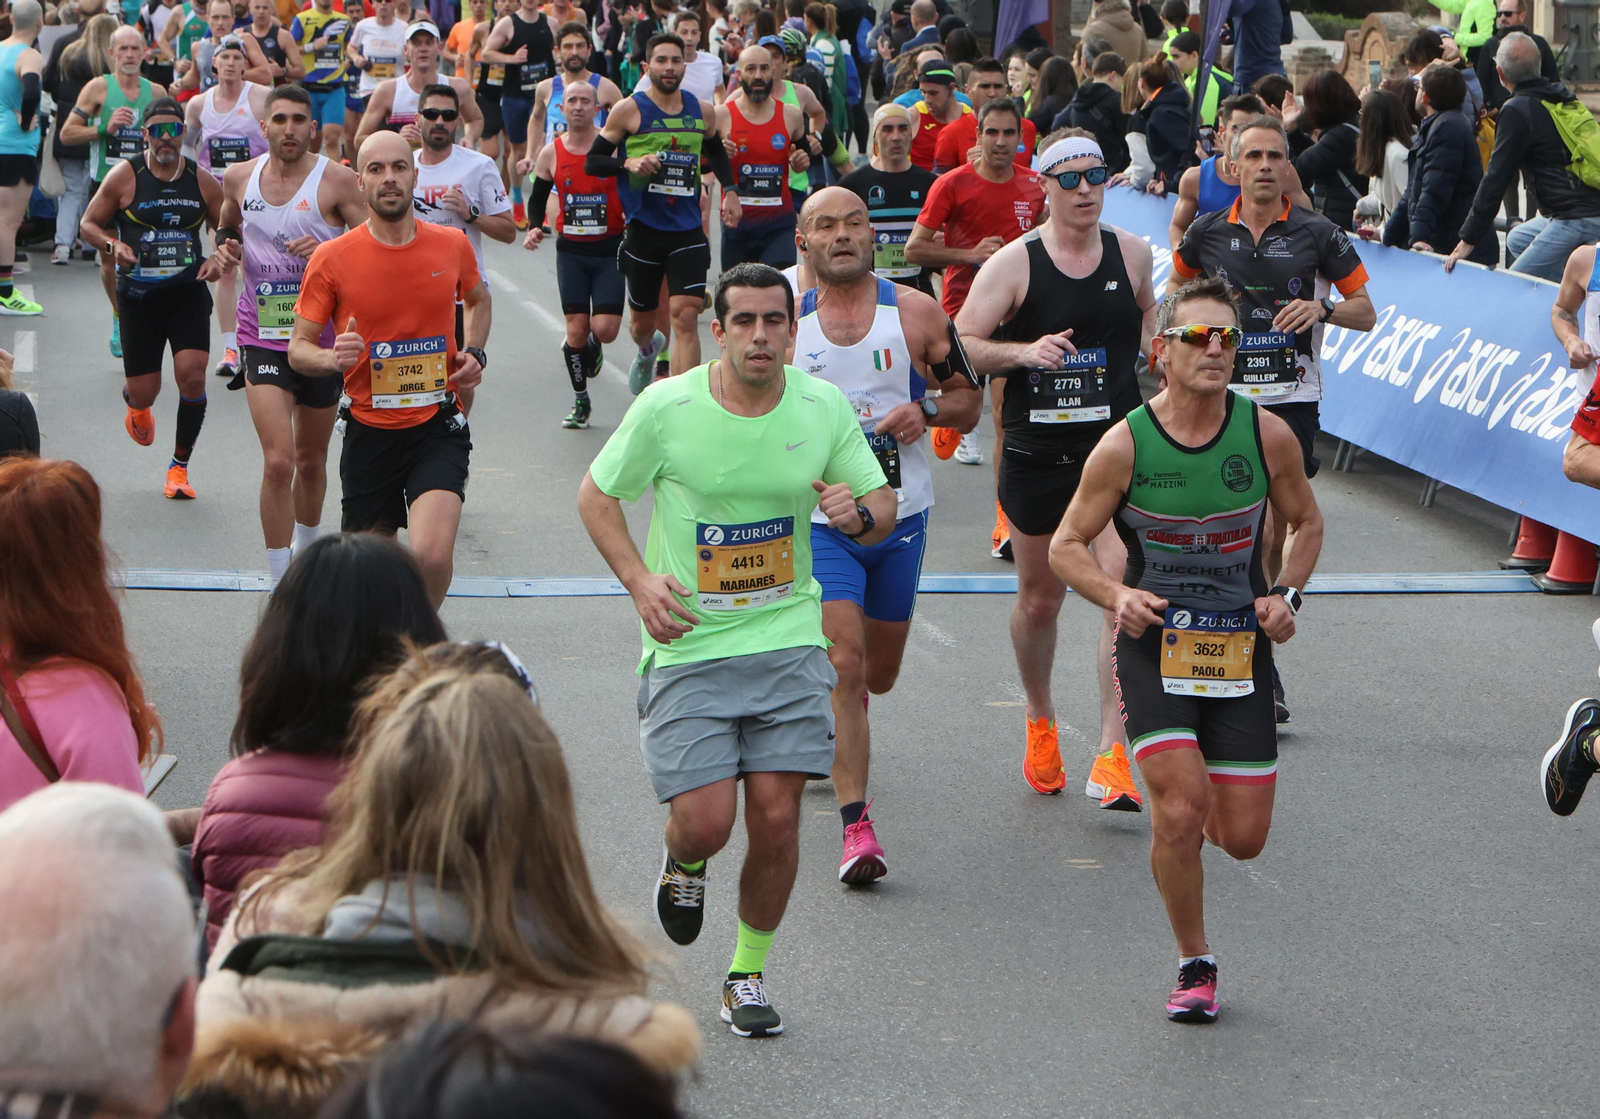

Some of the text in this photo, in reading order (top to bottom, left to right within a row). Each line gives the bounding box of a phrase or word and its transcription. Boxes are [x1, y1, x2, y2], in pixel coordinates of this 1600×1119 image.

[1043, 152, 1105, 172] MPRESSPO
[667, 168, 684, 176] 2832
[753, 180, 770, 188] 3492
[158, 247, 177, 256] 2248
[260, 264, 281, 274] REY
[1104, 280, 1119, 291] NB
[277, 318, 295, 326] ISAA
[1245, 335, 1287, 346] ZURICH
[396, 340, 438, 354] ZURICH
[1063, 352, 1097, 365] URICH
[1246, 356, 1270, 368] 2391
[257, 364, 279, 376] ISAAC
[397, 364, 424, 376] 3742
[570, 354, 583, 383] WONG
[397, 382, 426, 393] JORGE
[1054, 377, 1082, 390] 2779
[1057, 396, 1082, 407] ALAN
[861, 421, 877, 432] RMO
[869, 434, 888, 447] ICH
[1150, 480, 1187, 489] MAZZINI
[730, 522, 783, 542] ZURICH
[1146, 524, 1253, 546] CANAVESE TRIATHLON
[731, 554, 764, 570] 4413
[1152, 561, 1247, 577] LUCCHETTI
[720, 574, 776, 591] MARIARES
[1178, 581, 1221, 596] ITA
[1193, 642, 1226, 657] 3623
[1191, 665, 1226, 678] PAOLO
